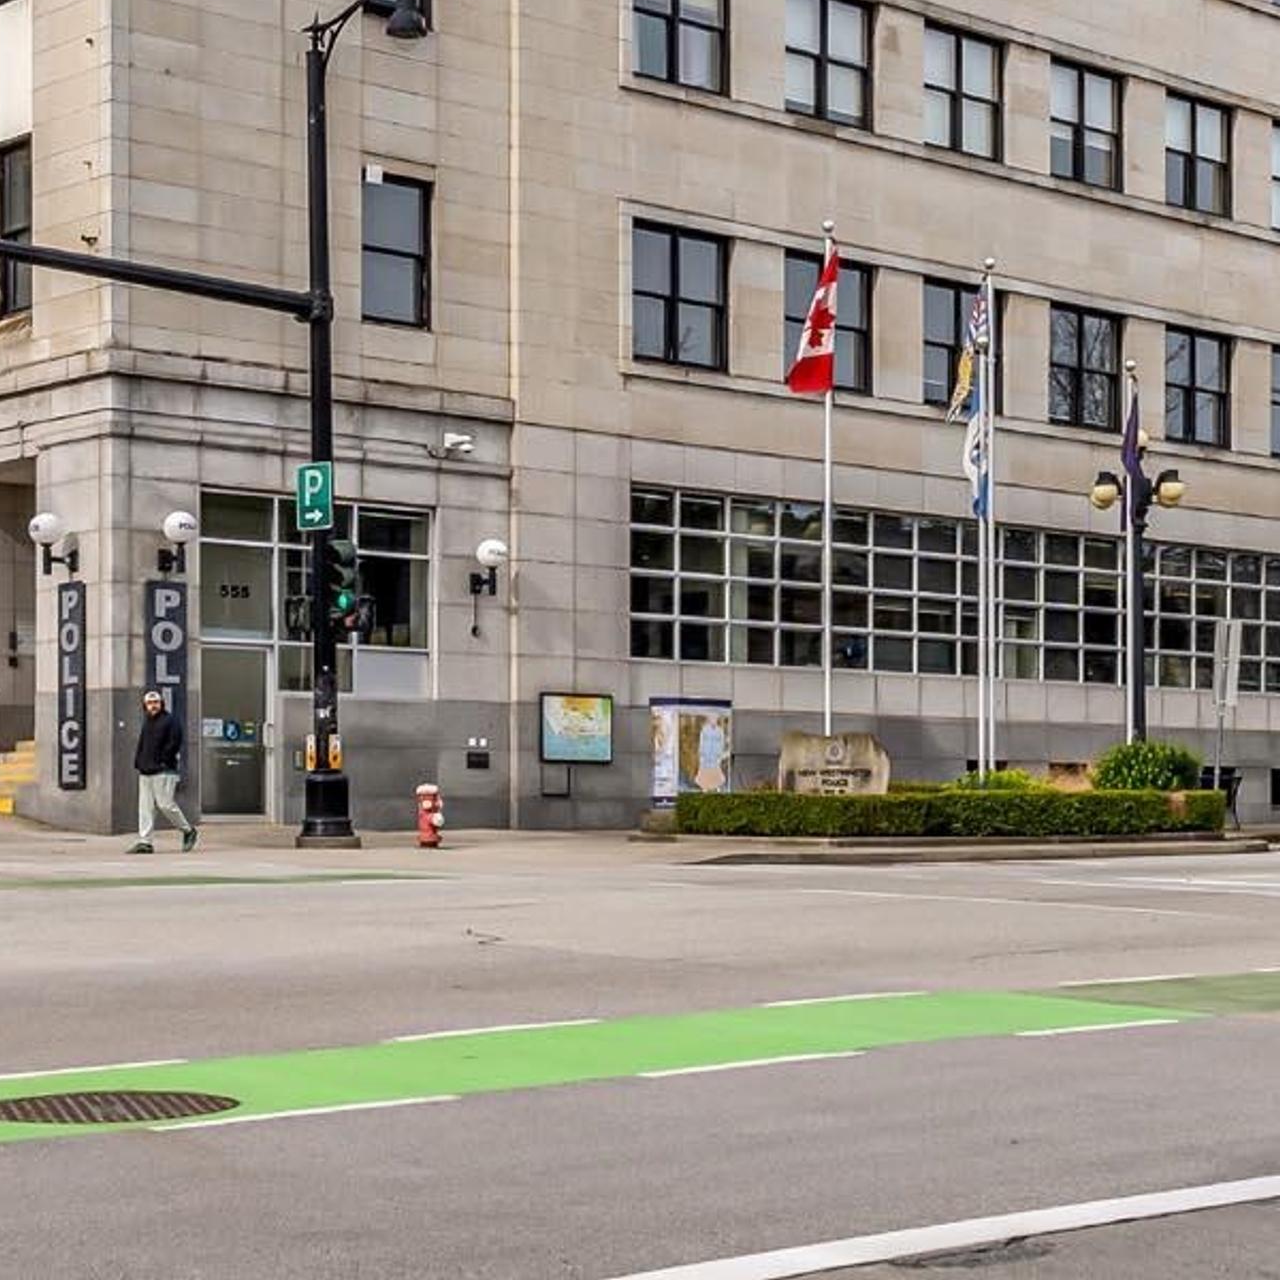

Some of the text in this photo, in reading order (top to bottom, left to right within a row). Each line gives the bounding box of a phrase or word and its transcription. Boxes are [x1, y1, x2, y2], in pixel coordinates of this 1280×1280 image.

[305, 469, 323, 506] P
[220, 584, 250, 598] 555
[60, 590, 79, 782] POLICE
[151, 588, 183, 714] POLI
